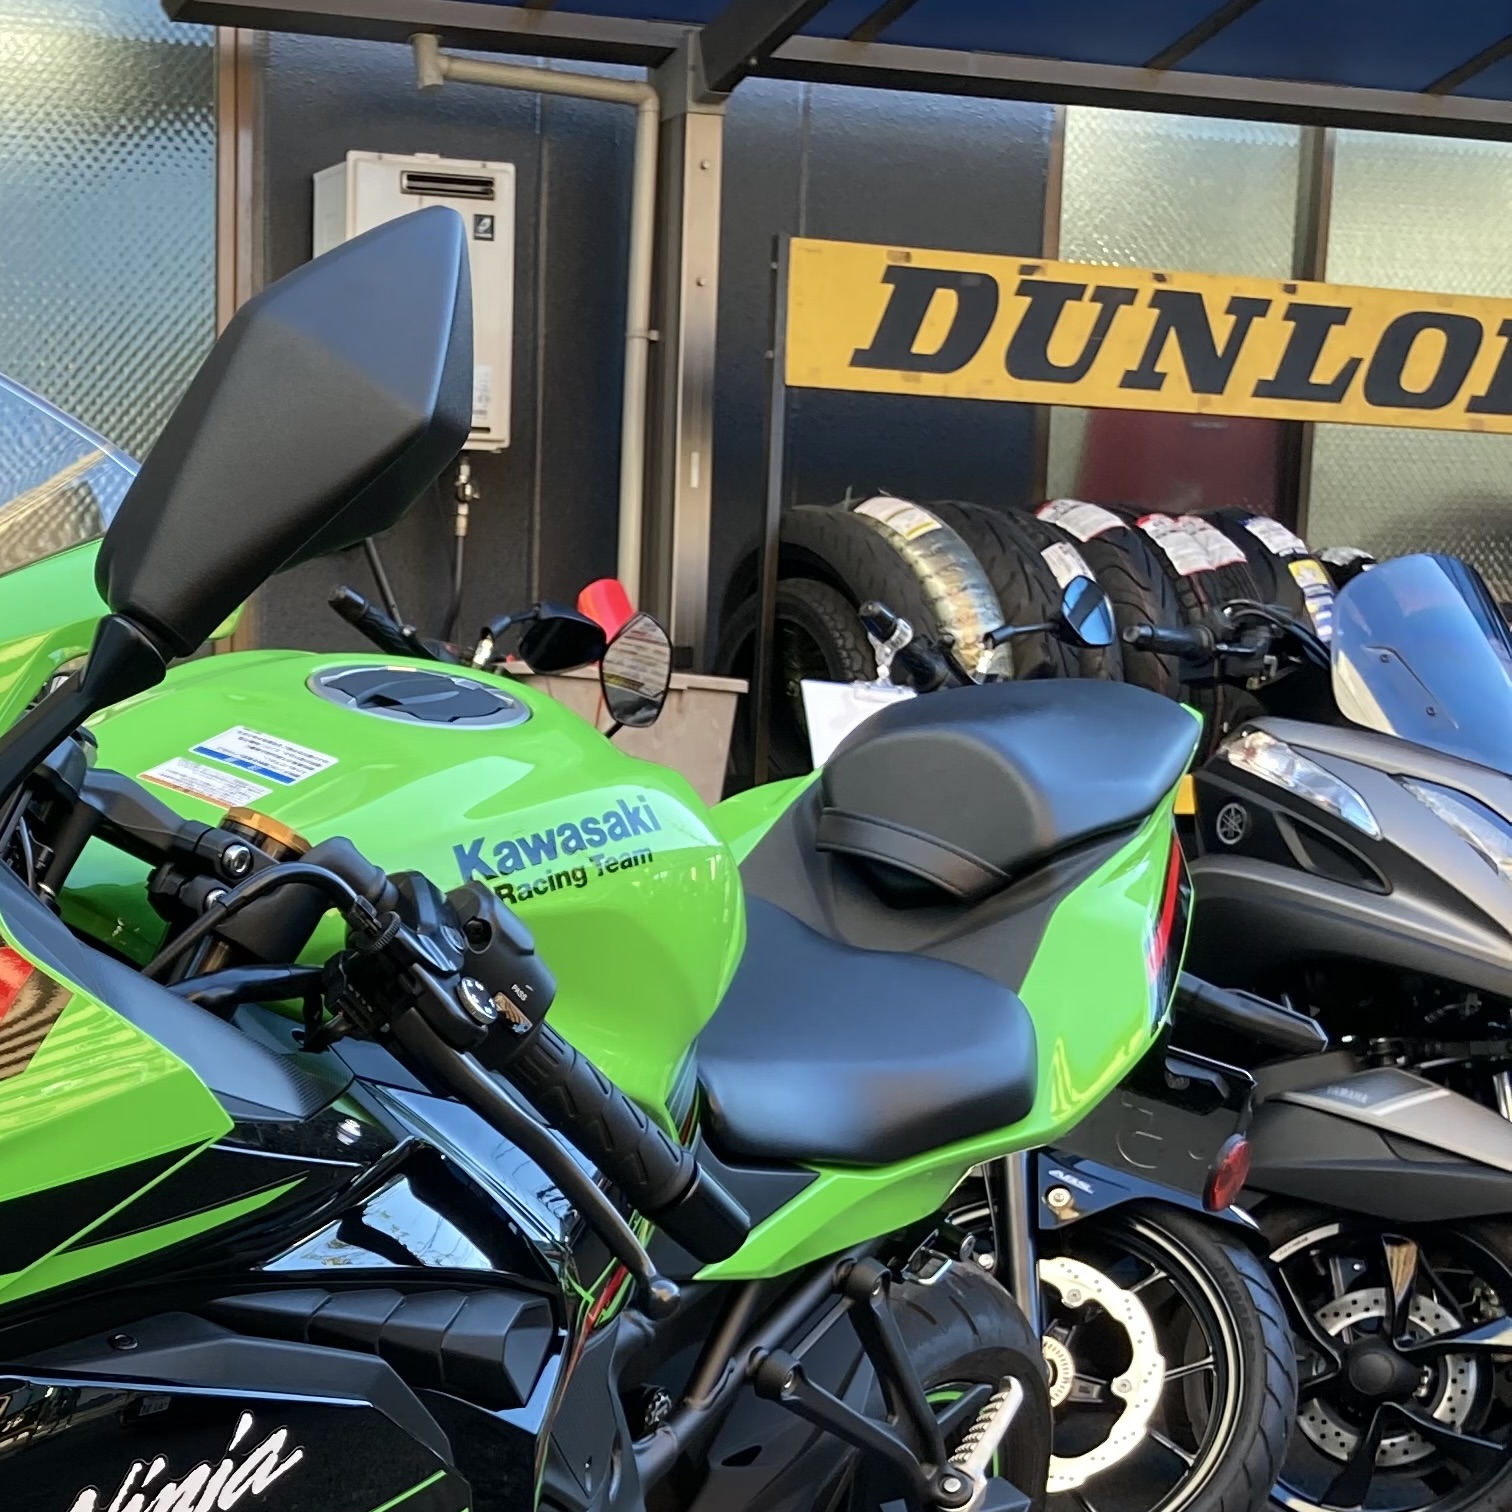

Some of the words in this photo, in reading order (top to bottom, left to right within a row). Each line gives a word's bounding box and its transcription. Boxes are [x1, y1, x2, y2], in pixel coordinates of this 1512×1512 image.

[452, 794, 662, 886] Kawasaki
[494, 864, 588, 905] Racing
[589, 847, 654, 877] Team
[511, 983, 528, 1001] PASS
